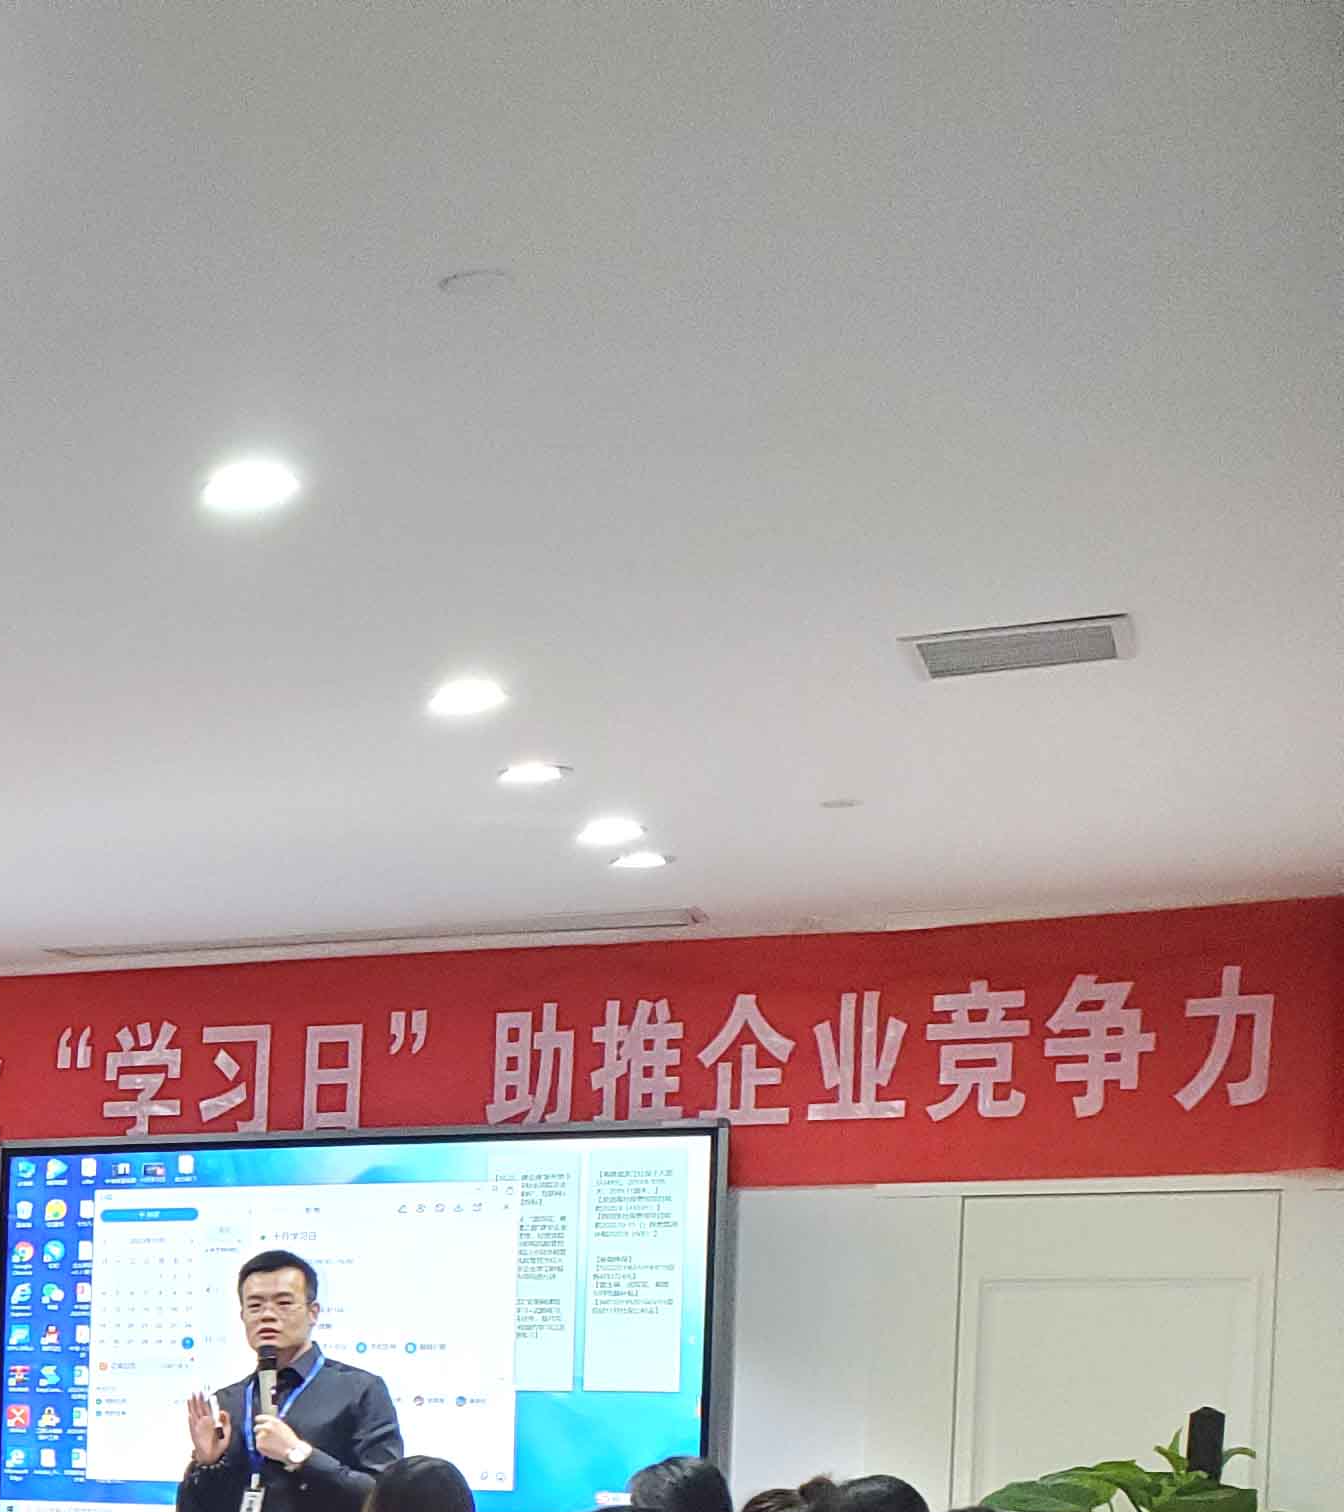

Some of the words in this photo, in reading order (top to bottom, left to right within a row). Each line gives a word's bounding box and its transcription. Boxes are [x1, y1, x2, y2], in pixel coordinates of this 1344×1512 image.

[56, 1009, 428, 1137] “学习日”
[485, 965, 1275, 1126] 助推企业竞争力
